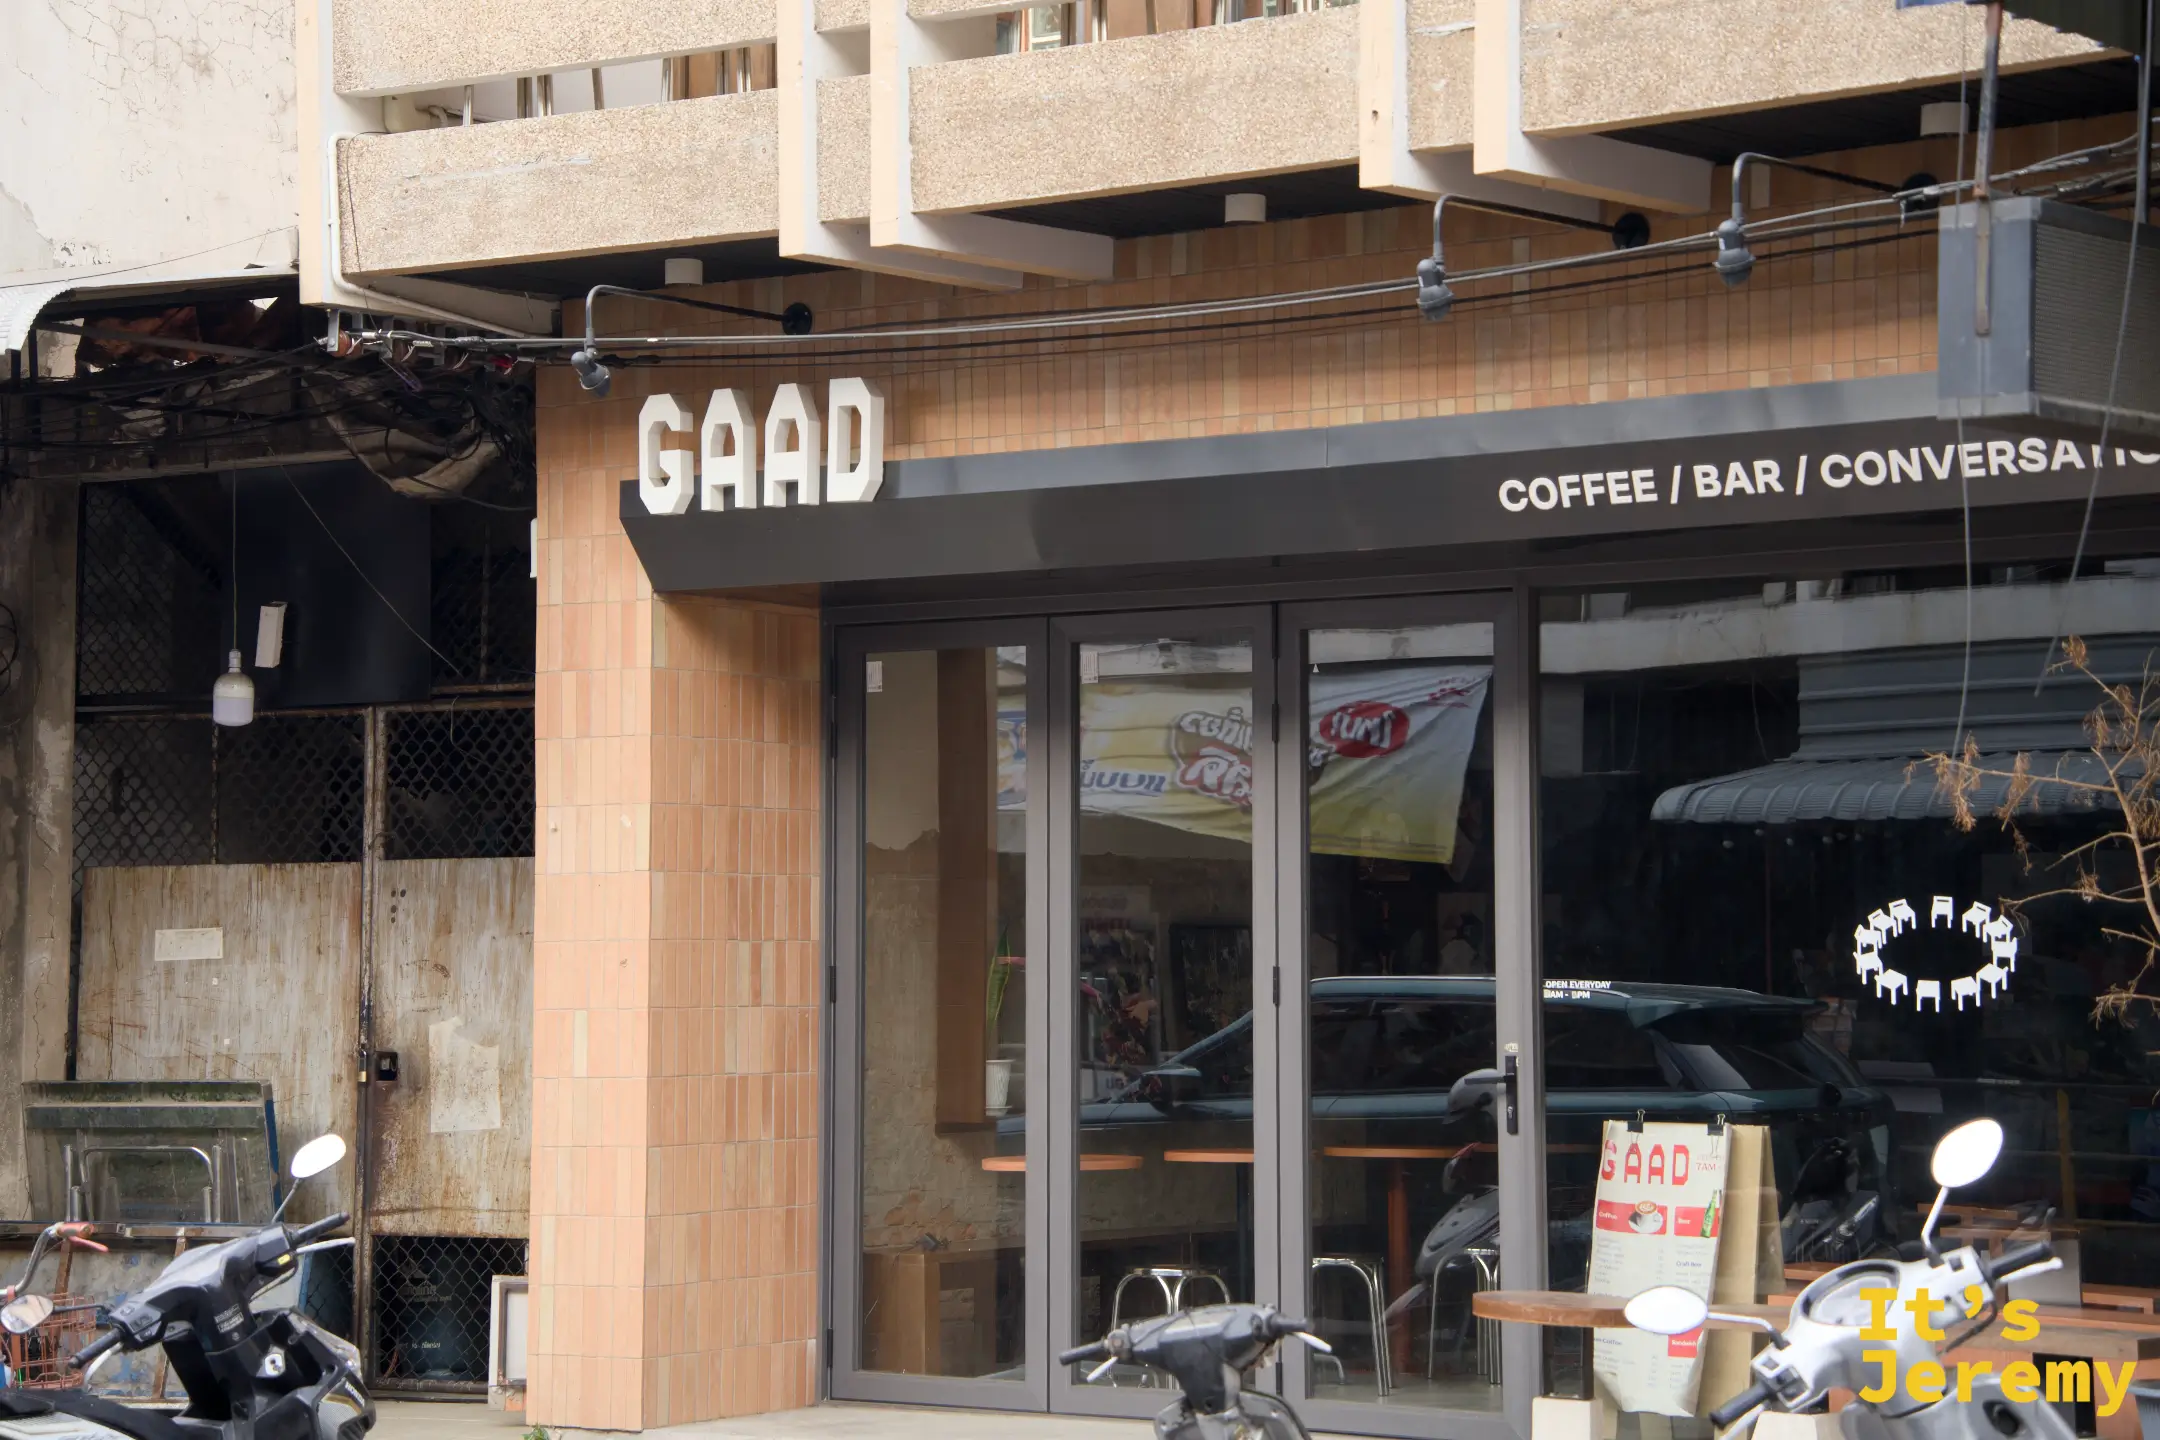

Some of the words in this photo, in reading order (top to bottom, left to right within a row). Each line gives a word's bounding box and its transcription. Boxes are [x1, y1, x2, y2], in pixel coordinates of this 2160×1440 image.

[638, 376, 885, 515] GAAD
[1498, 466, 1658, 512] COFFEE
[1693, 458, 1784, 498] BAR
[1543, 989, 1564, 999] AM
[1571, 990, 1591, 1000] PM
[1545, 980, 1568, 989] OPEN
[1569, 981, 1612, 989] EVERYDAY
[1601, 1139, 1690, 1186] GAAD
[1696, 1162, 1716, 1172] 7AM
[344, 1381, 366, 1407] HONDA
